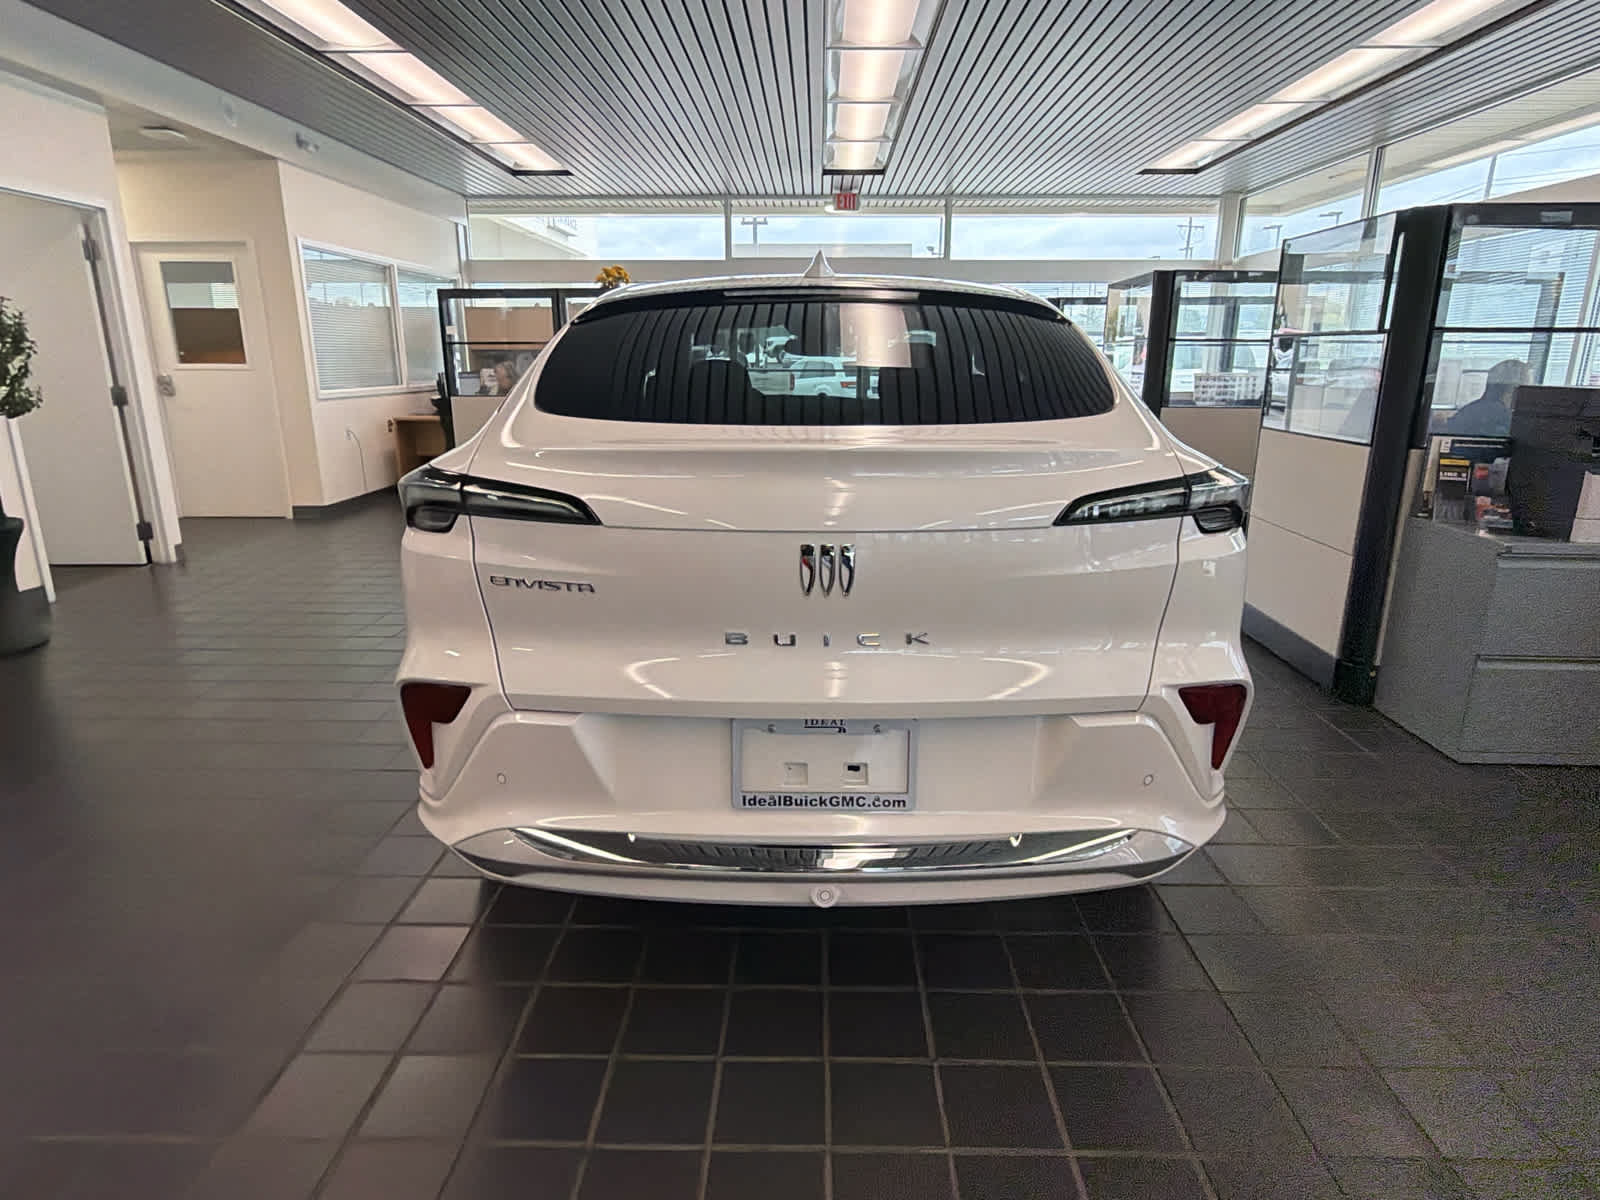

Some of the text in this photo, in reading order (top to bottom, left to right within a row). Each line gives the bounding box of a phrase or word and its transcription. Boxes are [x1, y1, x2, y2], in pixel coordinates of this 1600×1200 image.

[836, 193, 857, 209] EXIT
[489, 575, 595, 593] ENVISTA
[725, 631, 930, 647] BUICK
[742, 794, 907, 808] IdealBuickGMC.com
